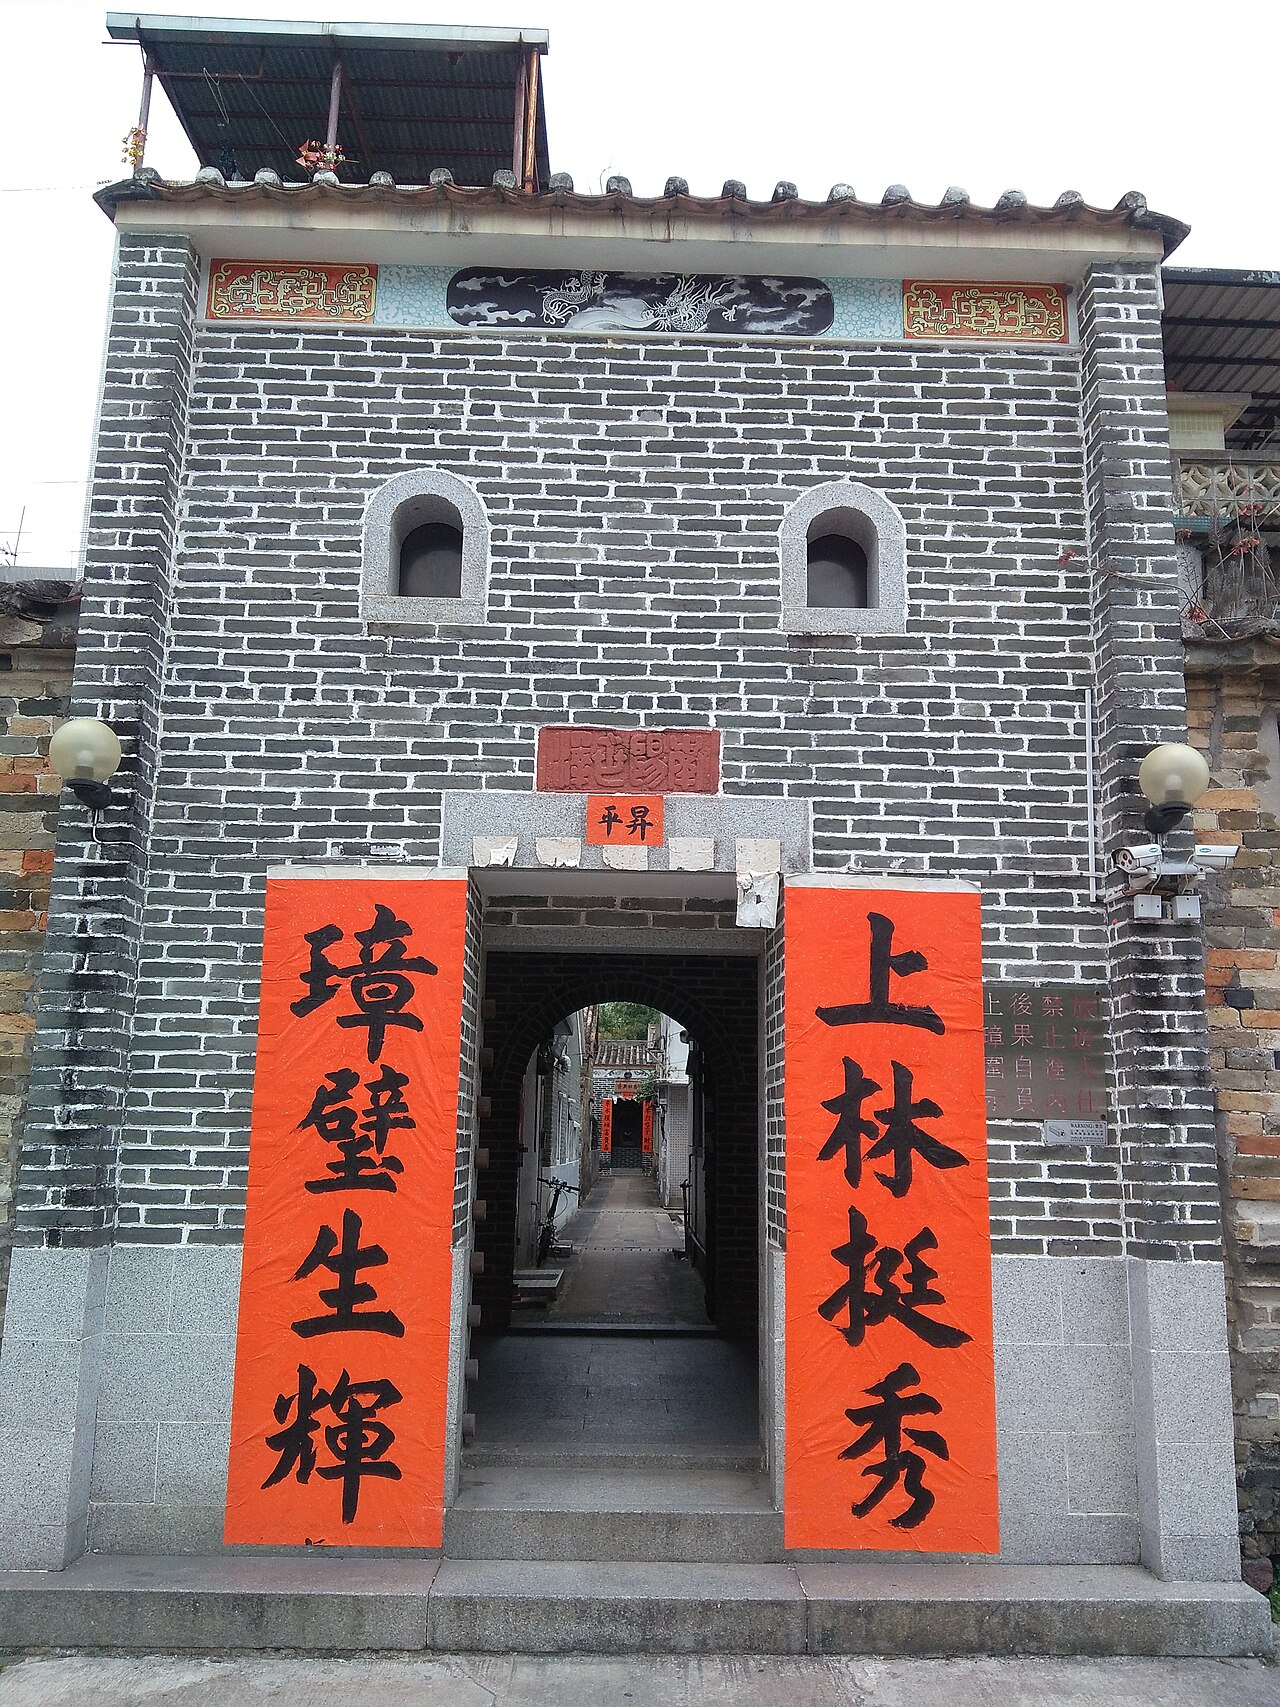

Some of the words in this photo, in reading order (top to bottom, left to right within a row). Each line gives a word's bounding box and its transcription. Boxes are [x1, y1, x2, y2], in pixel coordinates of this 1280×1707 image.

[261, 903, 438, 1524] 璋璧生輝
[815, 911, 973, 1528] 上林挺秀
[1009, 991, 1035, 1113] 後果自負
